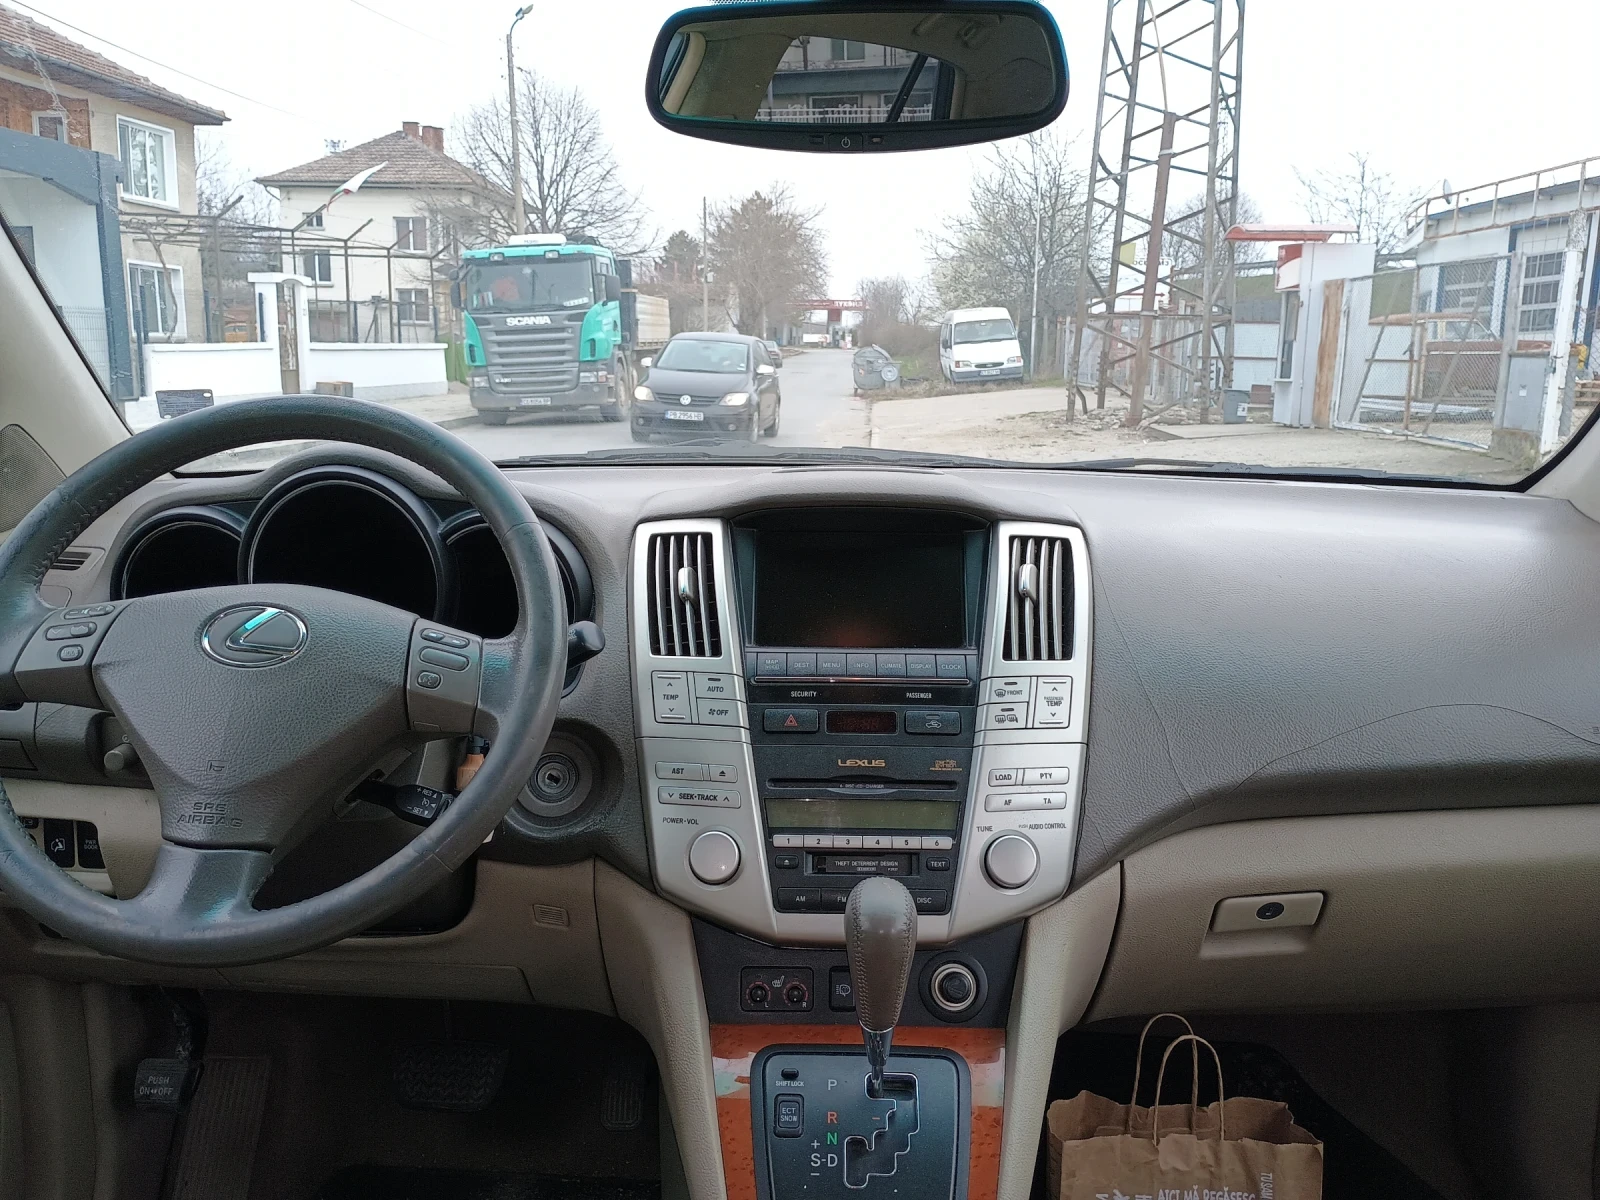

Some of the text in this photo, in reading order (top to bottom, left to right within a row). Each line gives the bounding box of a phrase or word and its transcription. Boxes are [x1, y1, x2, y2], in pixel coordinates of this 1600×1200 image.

[506, 315, 552, 327] SCANIA
[706, 685, 724, 693] AUTO
[662, 693, 679, 701] TEMP
[790, 690, 817, 698] SECURITY
[716, 709, 729, 717] OFF
[837, 759, 886, 767] LEXUS
[671, 767, 685, 775] AST
[994, 773, 1012, 782] LOAD
[1039, 771, 1053, 780] PTY
[1003, 798, 1012, 806] AF
[1043, 796, 1052, 805] TA
[193, 802, 226, 812] SRS
[176, 814, 243, 828] AIRBAG
[976, 825, 993, 833] TUNE
[1044, 822, 1066, 830] CONTROL
[930, 860, 946, 868] TEXT
[795, 895, 806, 903] AM
[837, 895, 847, 904] FM
[916, 897, 932, 905] DISC
[147, 1075, 170, 1085] PUSH
[827, 1079, 838, 1091] P
[139, 1086, 174, 1096] ON OFF
[780, 1114, 798, 1122] SNOW
[827, 1111, 838, 1124] R
[827, 1132, 838, 1145] N
